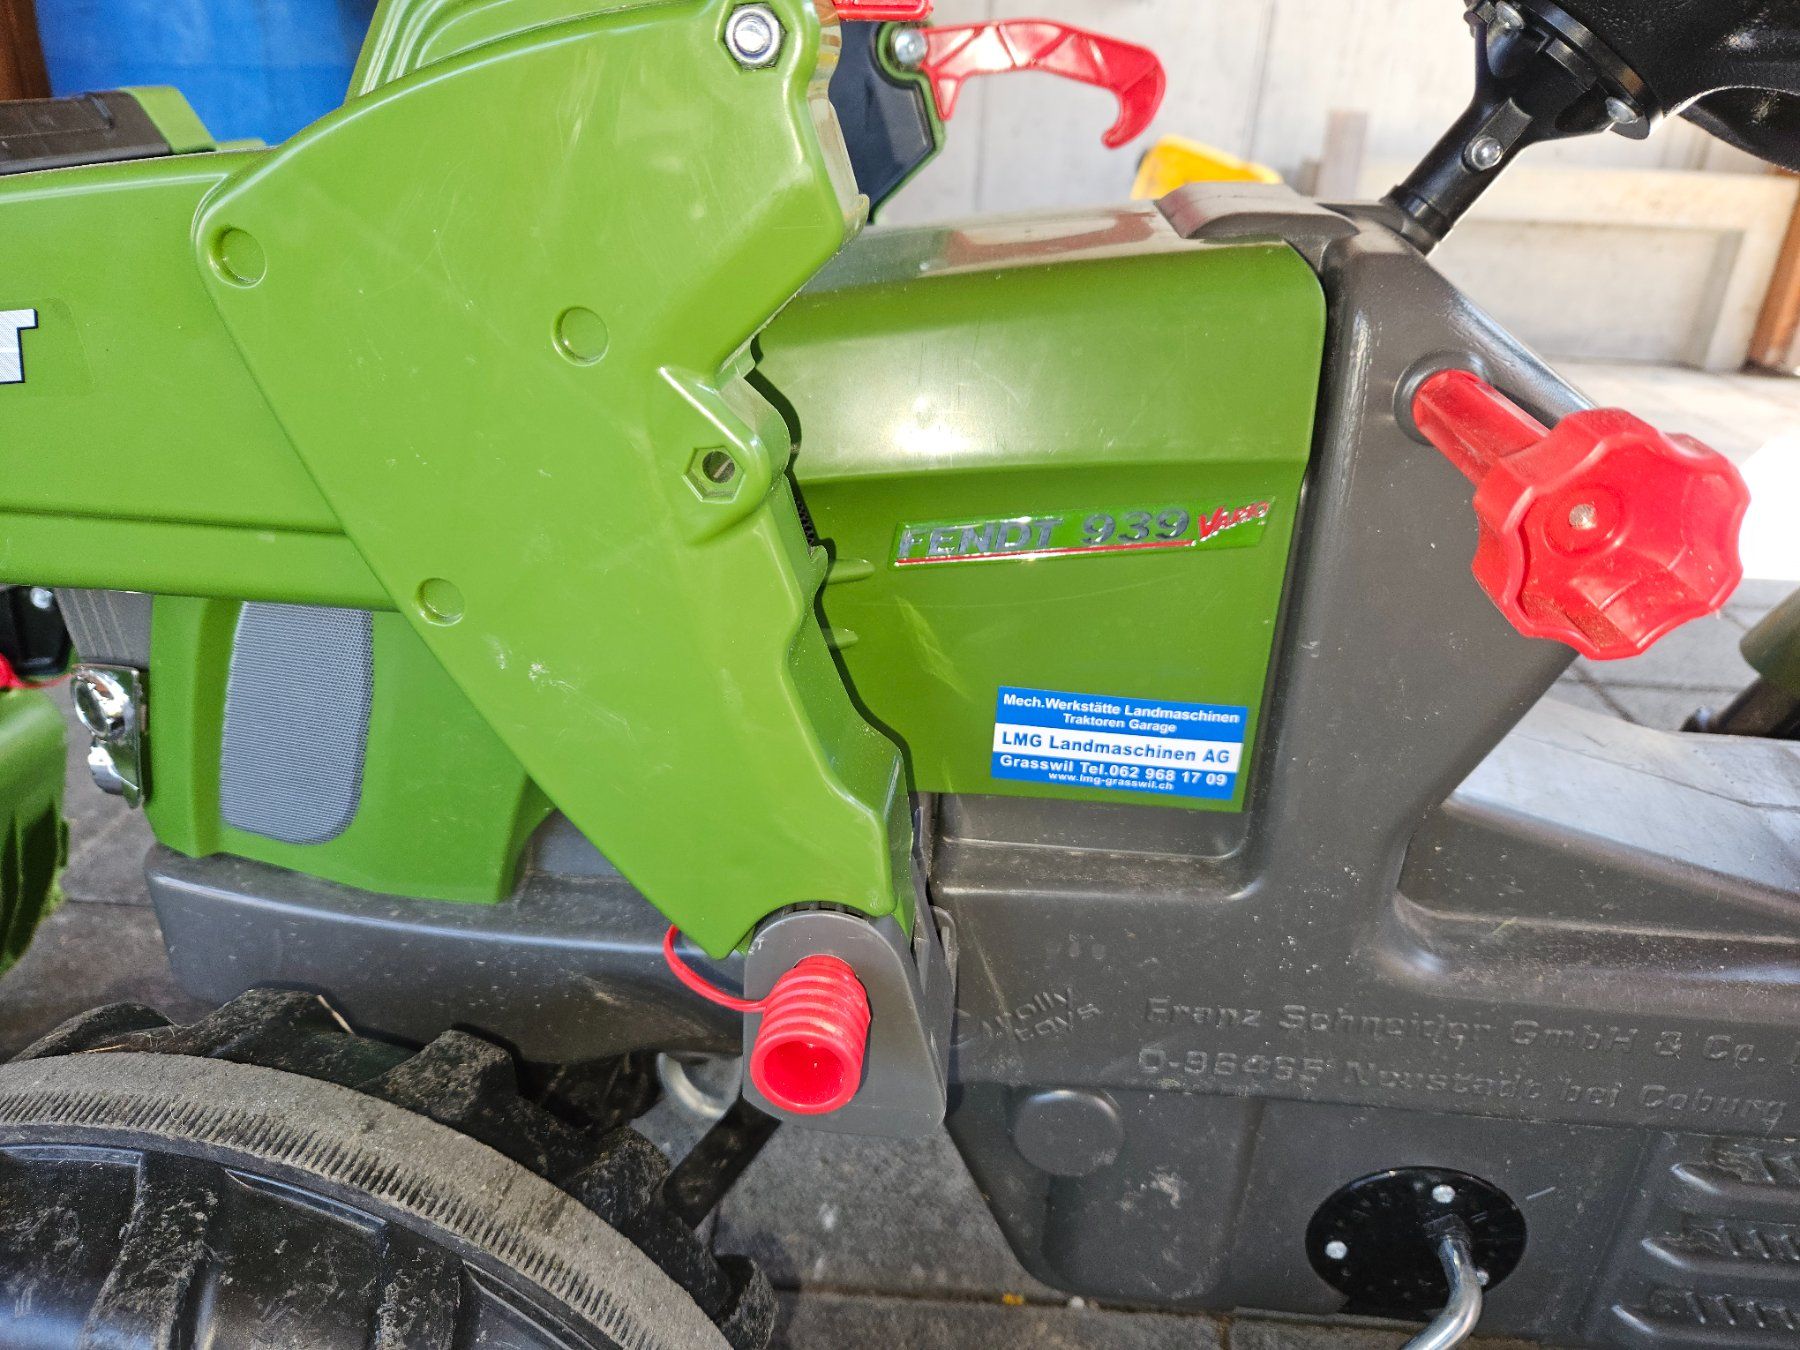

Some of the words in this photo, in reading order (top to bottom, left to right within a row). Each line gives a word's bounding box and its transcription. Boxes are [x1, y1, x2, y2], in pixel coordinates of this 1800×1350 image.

[900, 518, 1063, 558] FENDT
[1081, 508, 1190, 545] 939
[1062, 712, 1126, 729] Traktoren
[1128, 717, 1178, 734] Garage
[1124, 704, 1240, 724] Landmaschinen
[1002, 731, 1043, 748] LMG
[1049, 735, 1197, 762] Landmaschinen
[1202, 748, 1231, 764] AG
[1000, 755, 1074, 773] Grasswil
[1145, 768, 1176, 782] 968
[1181, 771, 1201, 784] 17
[1205, 773, 1228, 787] 09
